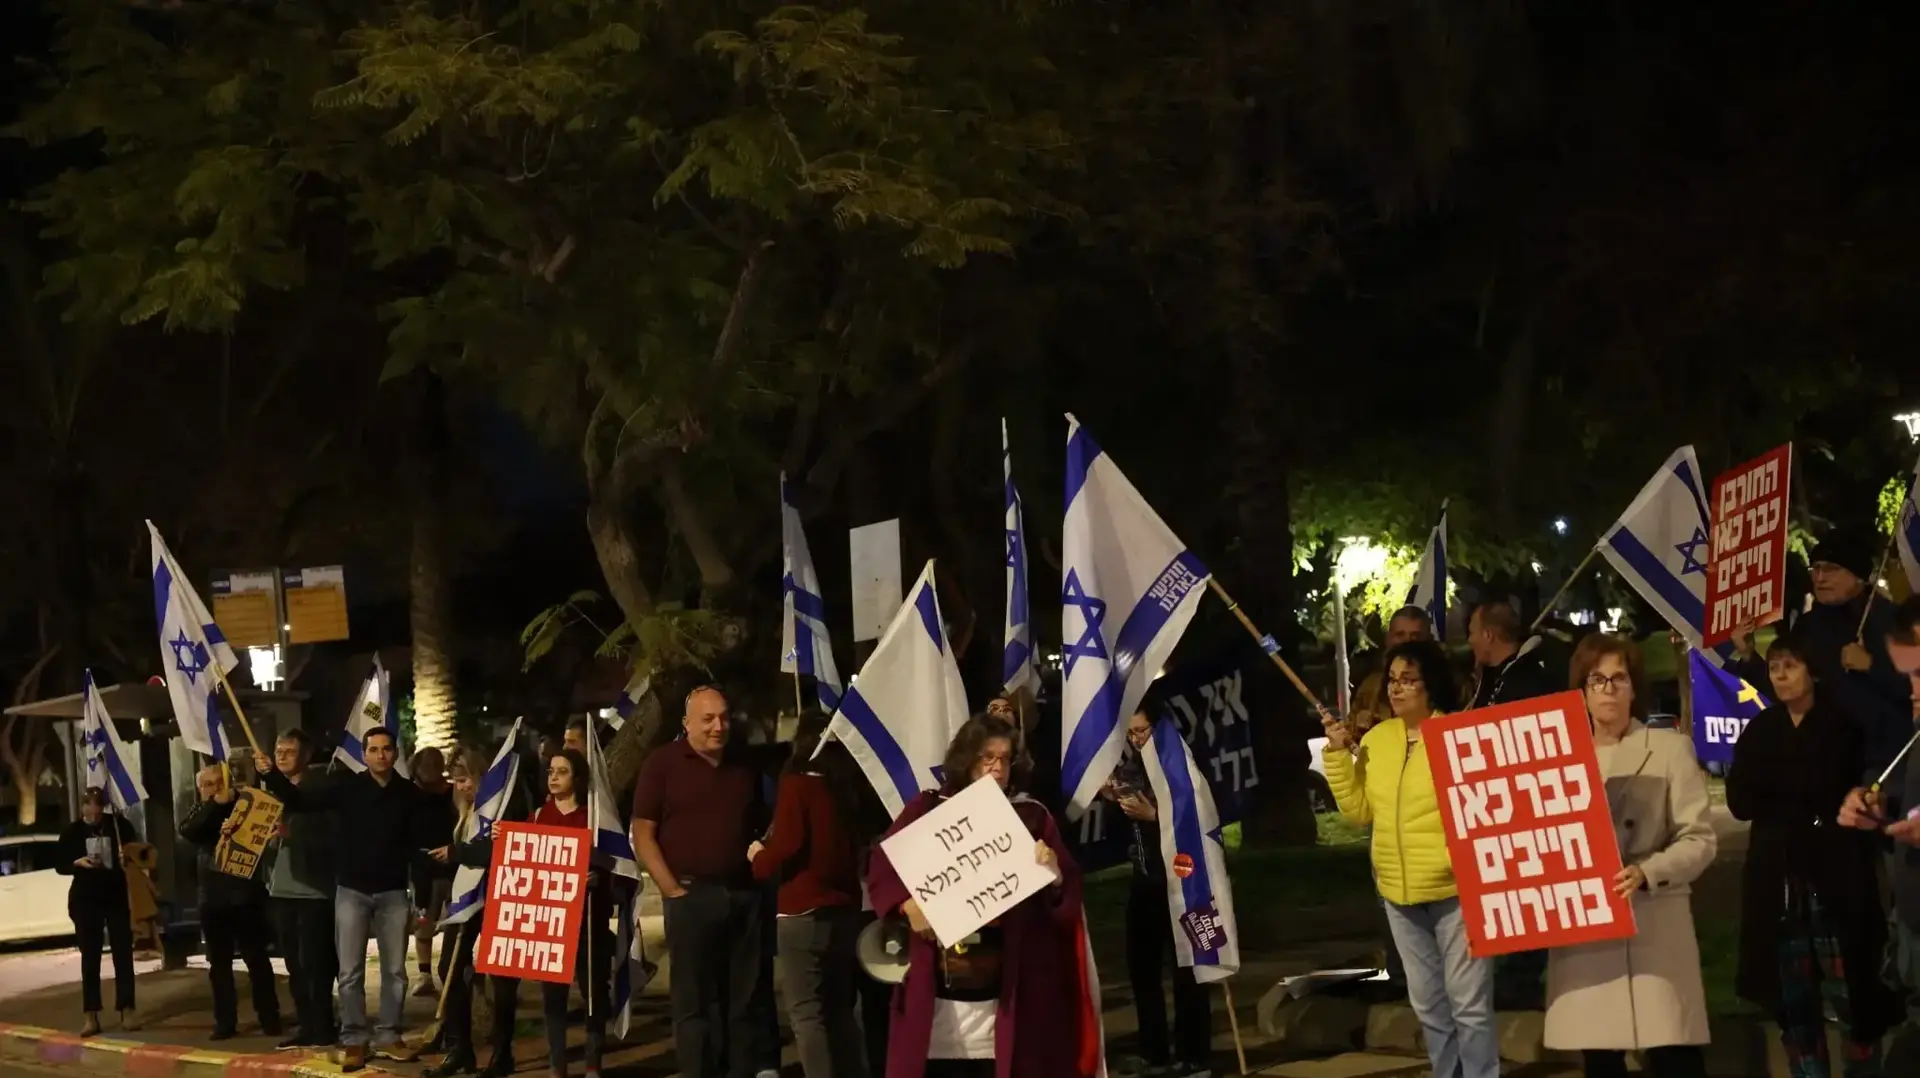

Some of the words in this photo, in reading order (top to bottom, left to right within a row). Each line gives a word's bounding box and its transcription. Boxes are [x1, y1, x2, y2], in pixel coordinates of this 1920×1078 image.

[1720, 458, 1779, 522] החורבן
[1713, 513, 1744, 563] כאן
[1746, 496, 1781, 540] כבר
[1148, 560, 1187, 598] חופשי
[1717, 540, 1772, 593] חייבים
[1159, 570, 1199, 612] בארצנו
[1711, 579, 1773, 635] בחירות
[1197, 668, 1248, 747] אין
[1443, 708, 1572, 784] החורבן
[1447, 777, 1514, 840] כאן
[1514, 763, 1592, 818] כבר
[503, 831, 579, 867] החורבן
[935, 816, 974, 852] דנון
[956, 832, 1012, 873] שותף
[1472, 822, 1593, 884] חייבים
[493, 865, 533, 900] כאן
[537, 869, 580, 902] כבר
[915, 866, 961, 903] מלא
[966, 872, 1019, 919] לבזיון
[497, 901, 567, 937] חייבים
[1480, 877, 1614, 940] בחירות
[487, 936, 565, 973] בחירות
